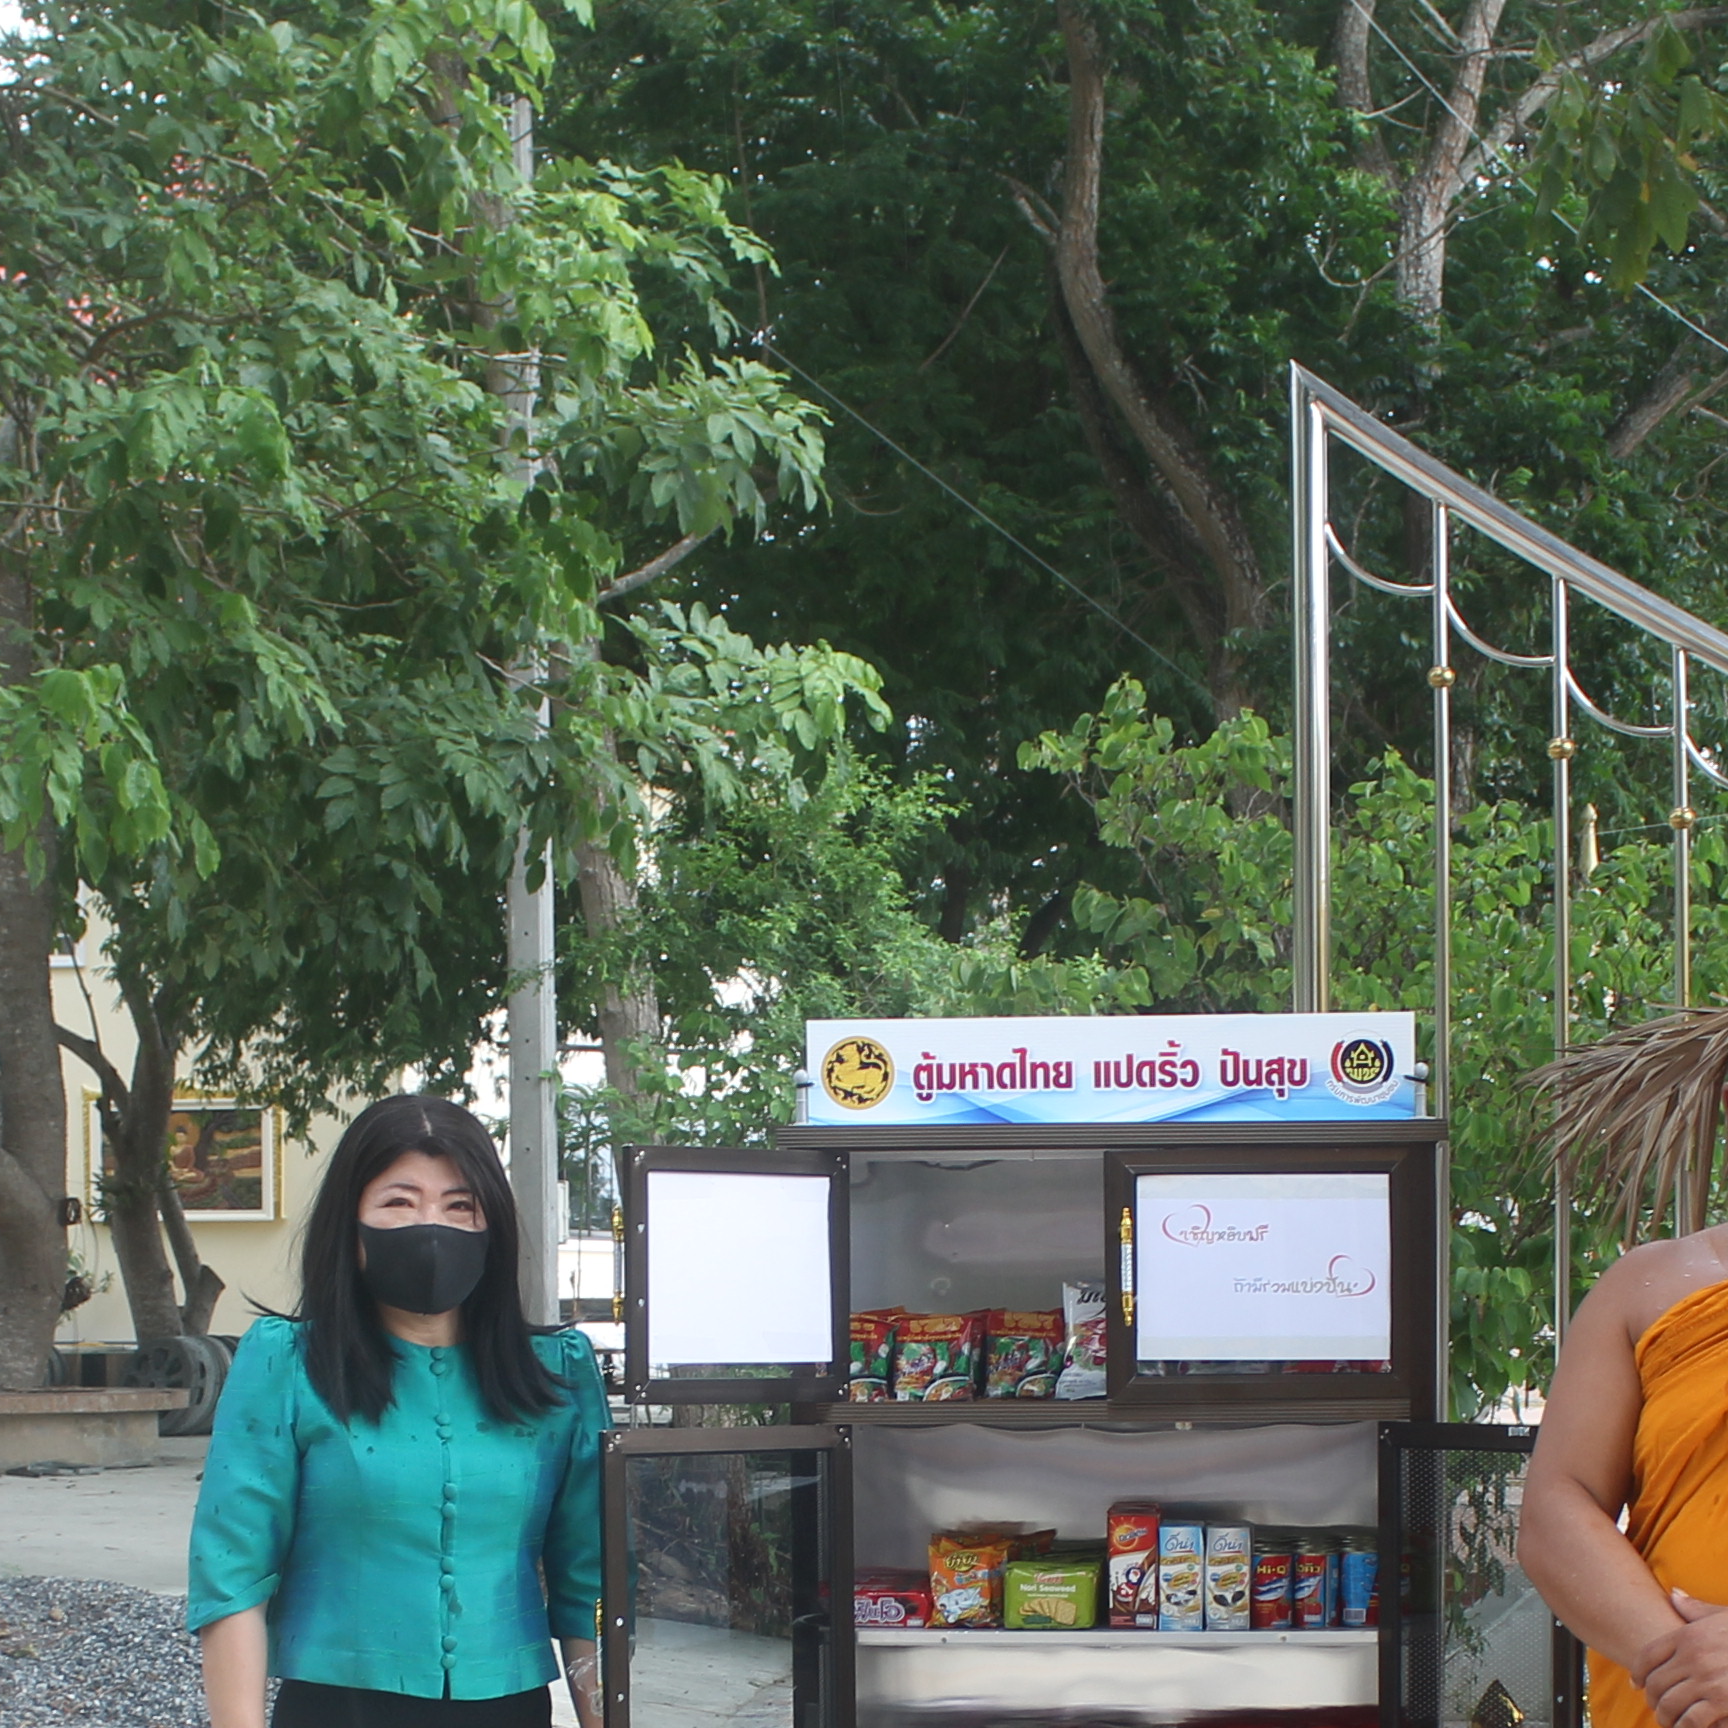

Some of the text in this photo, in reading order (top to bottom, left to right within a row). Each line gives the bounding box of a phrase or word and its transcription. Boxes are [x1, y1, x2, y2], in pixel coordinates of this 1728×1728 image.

[913, 1040, 1308, 1102] ตู้มหาดไทย แปดริ้ว ปันสุข
